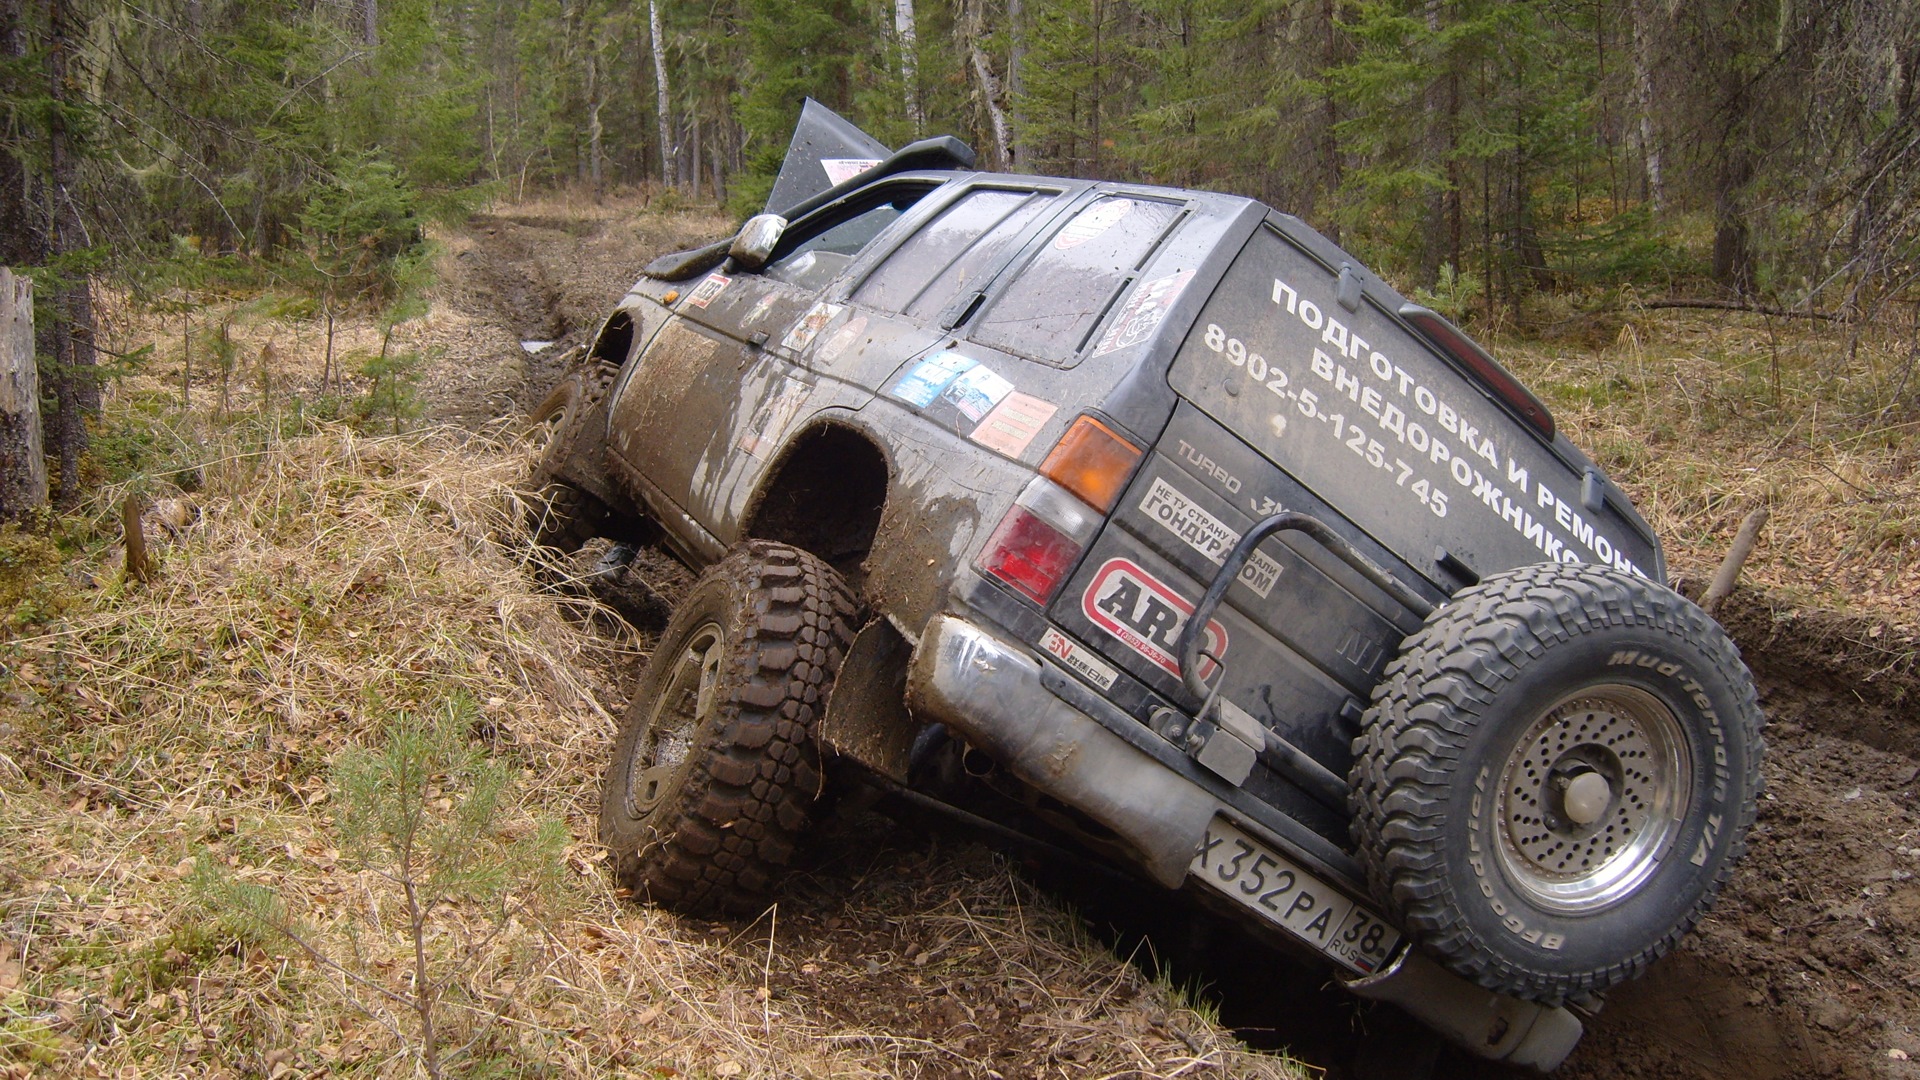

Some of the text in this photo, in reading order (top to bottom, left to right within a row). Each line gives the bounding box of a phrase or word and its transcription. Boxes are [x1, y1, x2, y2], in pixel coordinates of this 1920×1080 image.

[1204, 323, 1449, 518] 8902-5-125-745
[1271, 278, 1648, 579] ПОДГОТОВКА И РЕМОН
[1179, 439, 1242, 495] TURBO
[1146, 494, 1272, 592] ГОНДУРАОМ
[1156, 485, 1278, 577] НЕ ТУ СТРАНУ НВАЛИ
[1097, 576, 1209, 660] AR
[1690, 813, 1723, 867] T/A
[1329, 939, 1358, 962] RUS
[1343, 911, 1386, 955] 38
